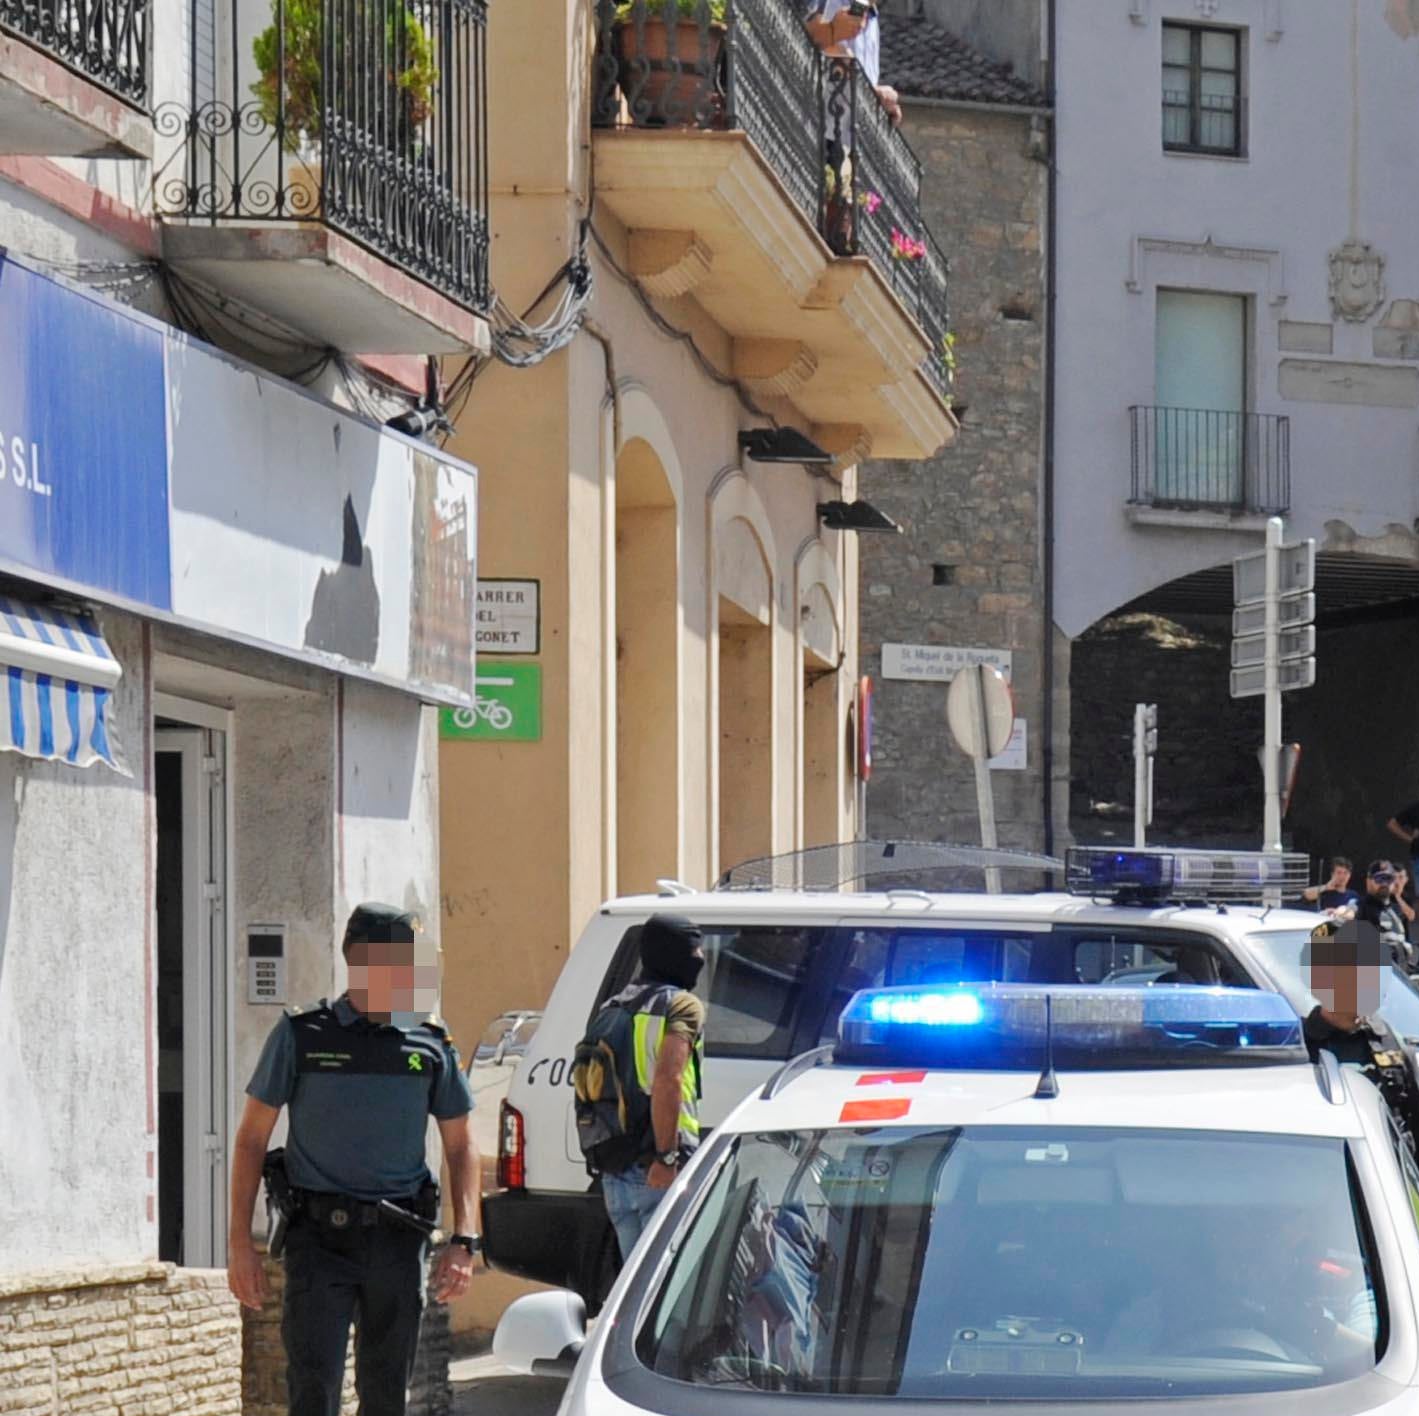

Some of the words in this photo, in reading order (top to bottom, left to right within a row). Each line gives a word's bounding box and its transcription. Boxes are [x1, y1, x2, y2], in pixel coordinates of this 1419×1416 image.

[11, 435, 52, 497] S.L.
[476, 590, 524, 604] ARRER
[476, 609, 496, 622] EL
